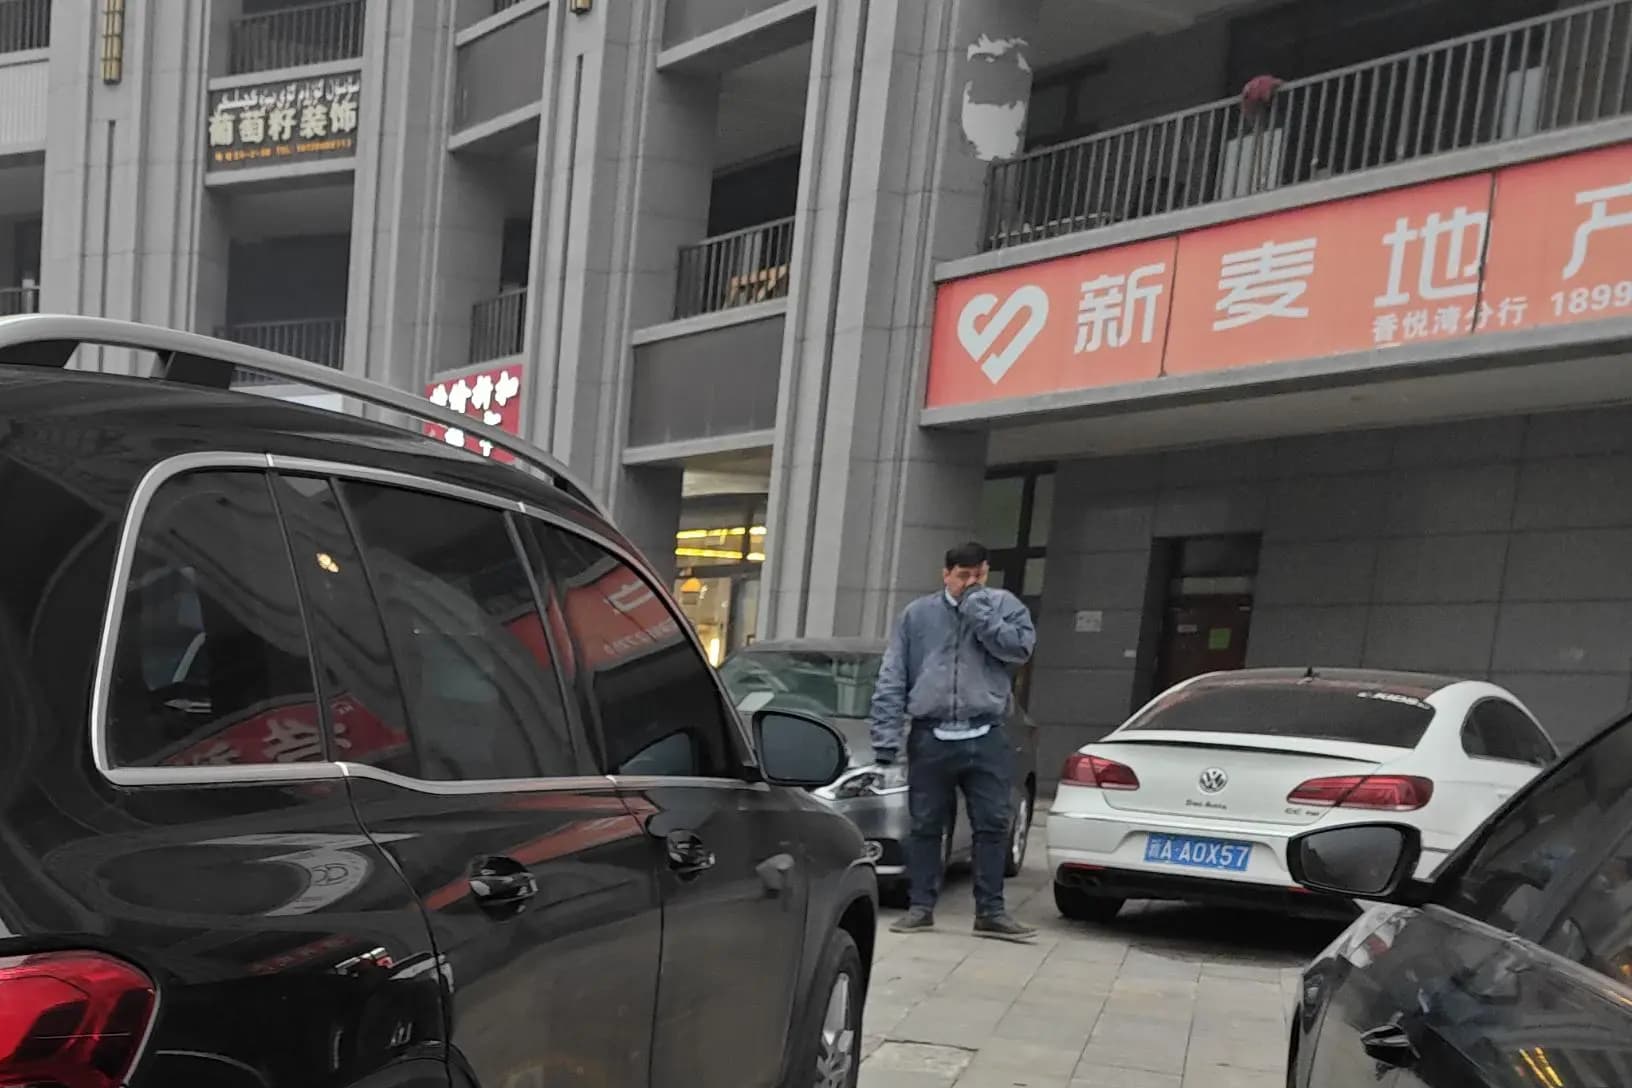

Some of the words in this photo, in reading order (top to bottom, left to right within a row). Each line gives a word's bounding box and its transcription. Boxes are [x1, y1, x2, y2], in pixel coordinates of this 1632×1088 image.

[209, 99, 357, 146] 葡萄籽装饰
[1372, 296, 1528, 342] 香悦湾分行
